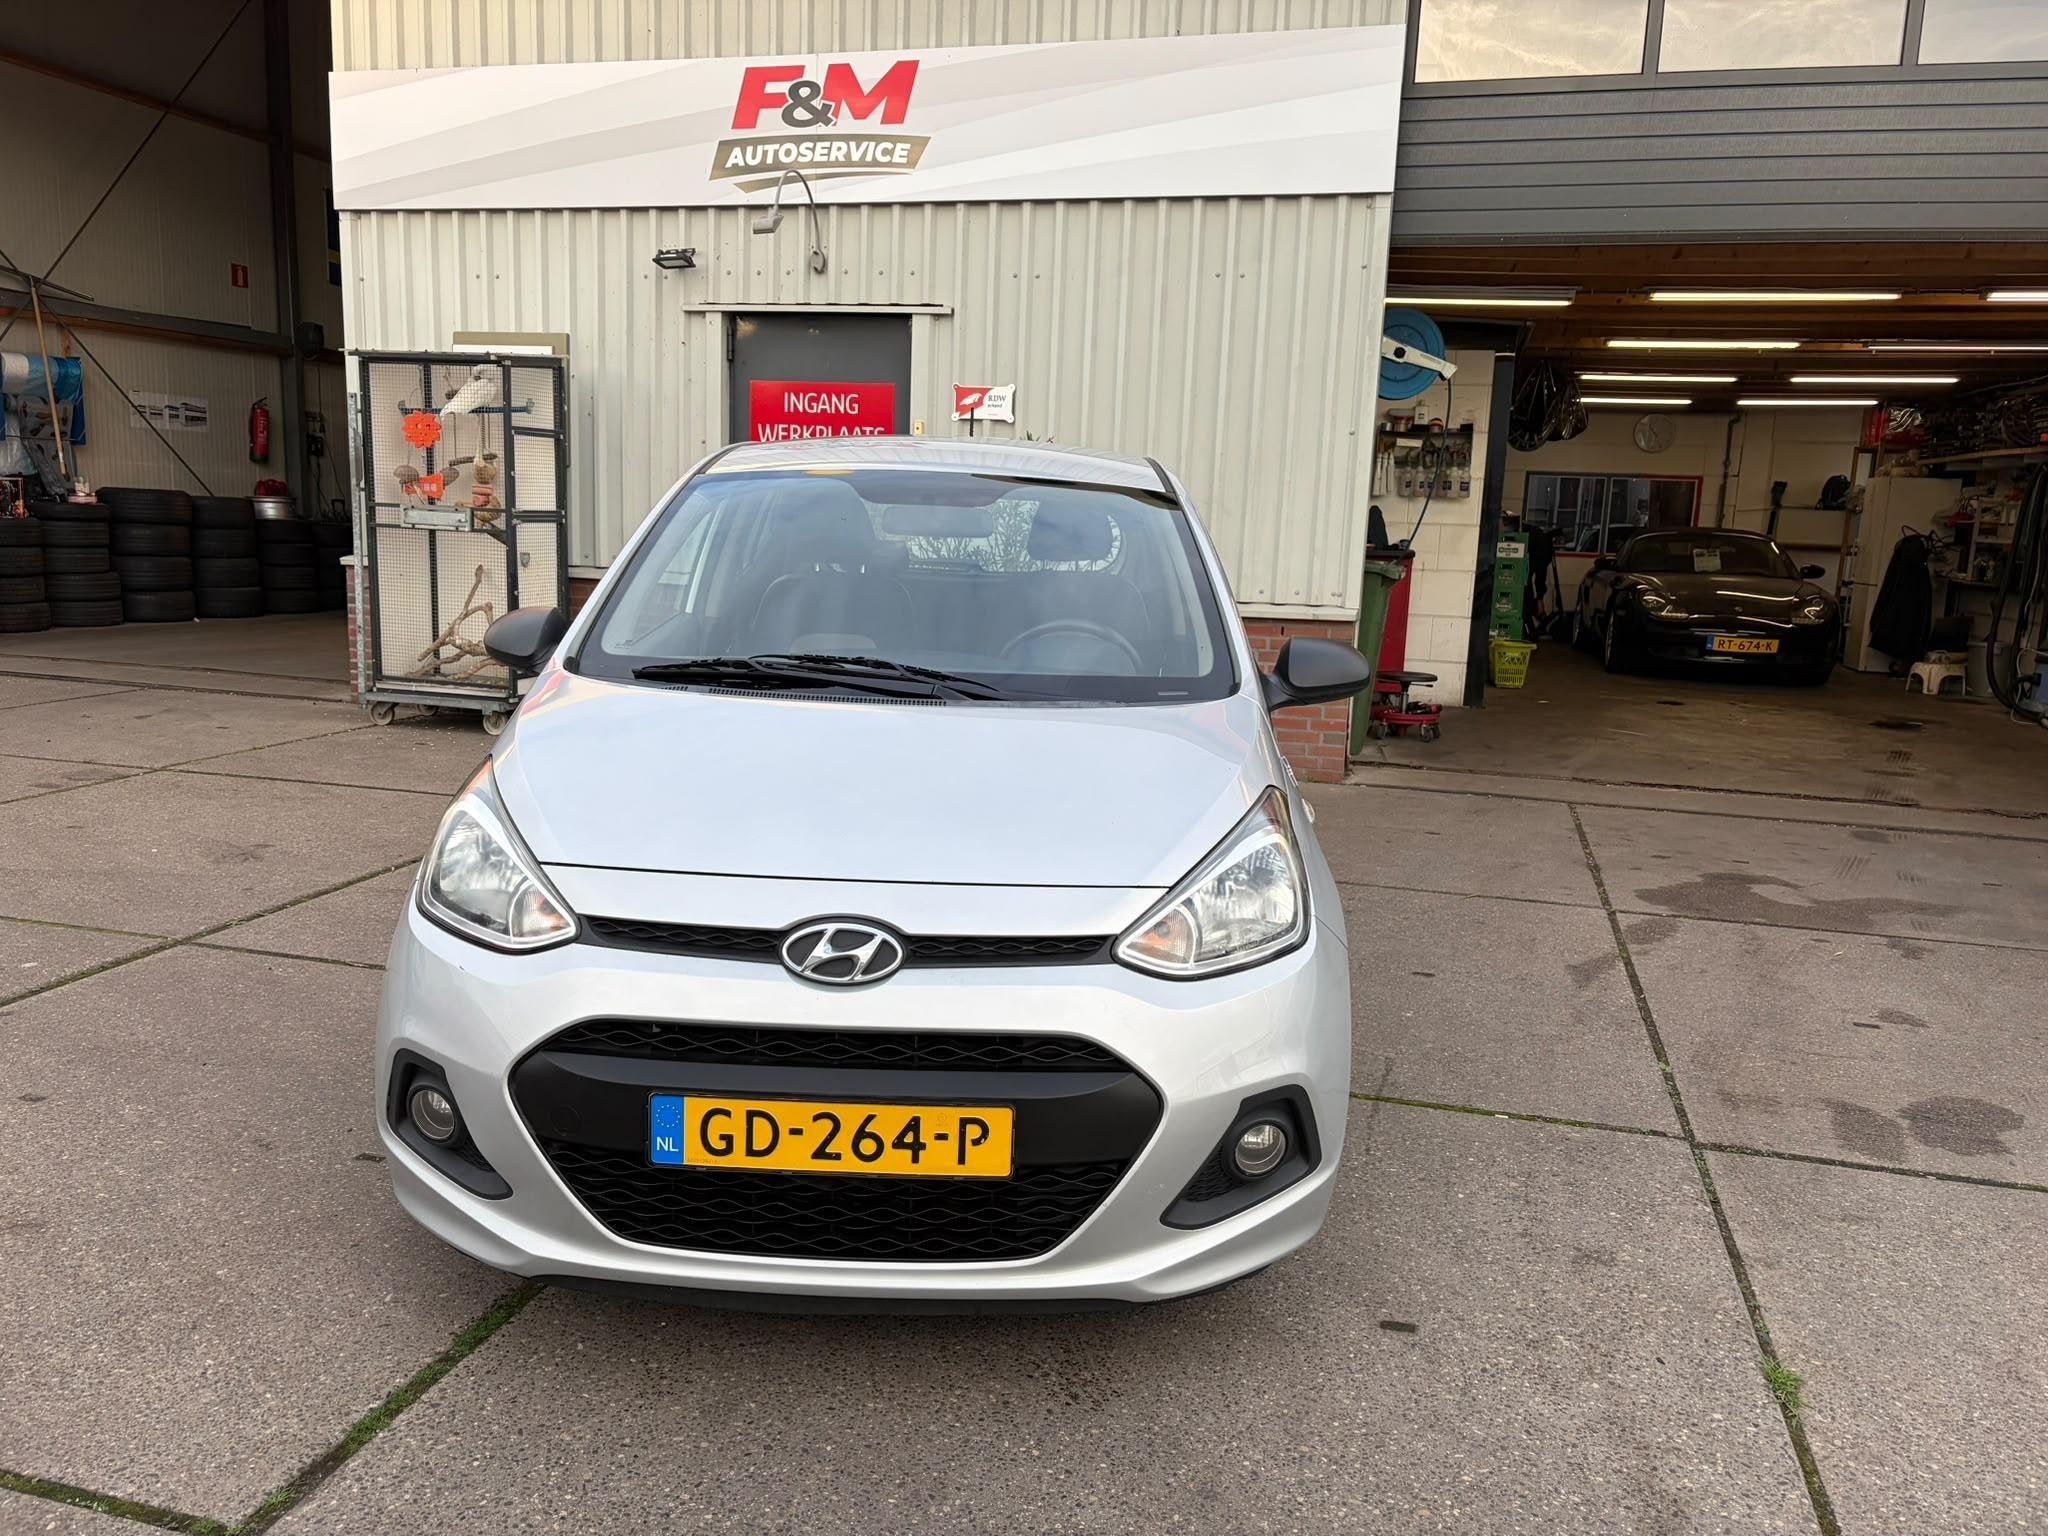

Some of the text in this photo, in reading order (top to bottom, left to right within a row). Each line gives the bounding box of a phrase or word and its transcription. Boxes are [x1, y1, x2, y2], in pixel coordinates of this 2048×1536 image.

[731, 60, 920, 129] F&M
[725, 141, 911, 168] AUTOSERVICE
[783, 391, 859, 415] INGANG
[988, 394, 1007, 402] RDW
[1717, 639, 1774, 652] RT-674-K
[656, 1136, 680, 1152] NL
[699, 1107, 990, 1166] GD-264-P
